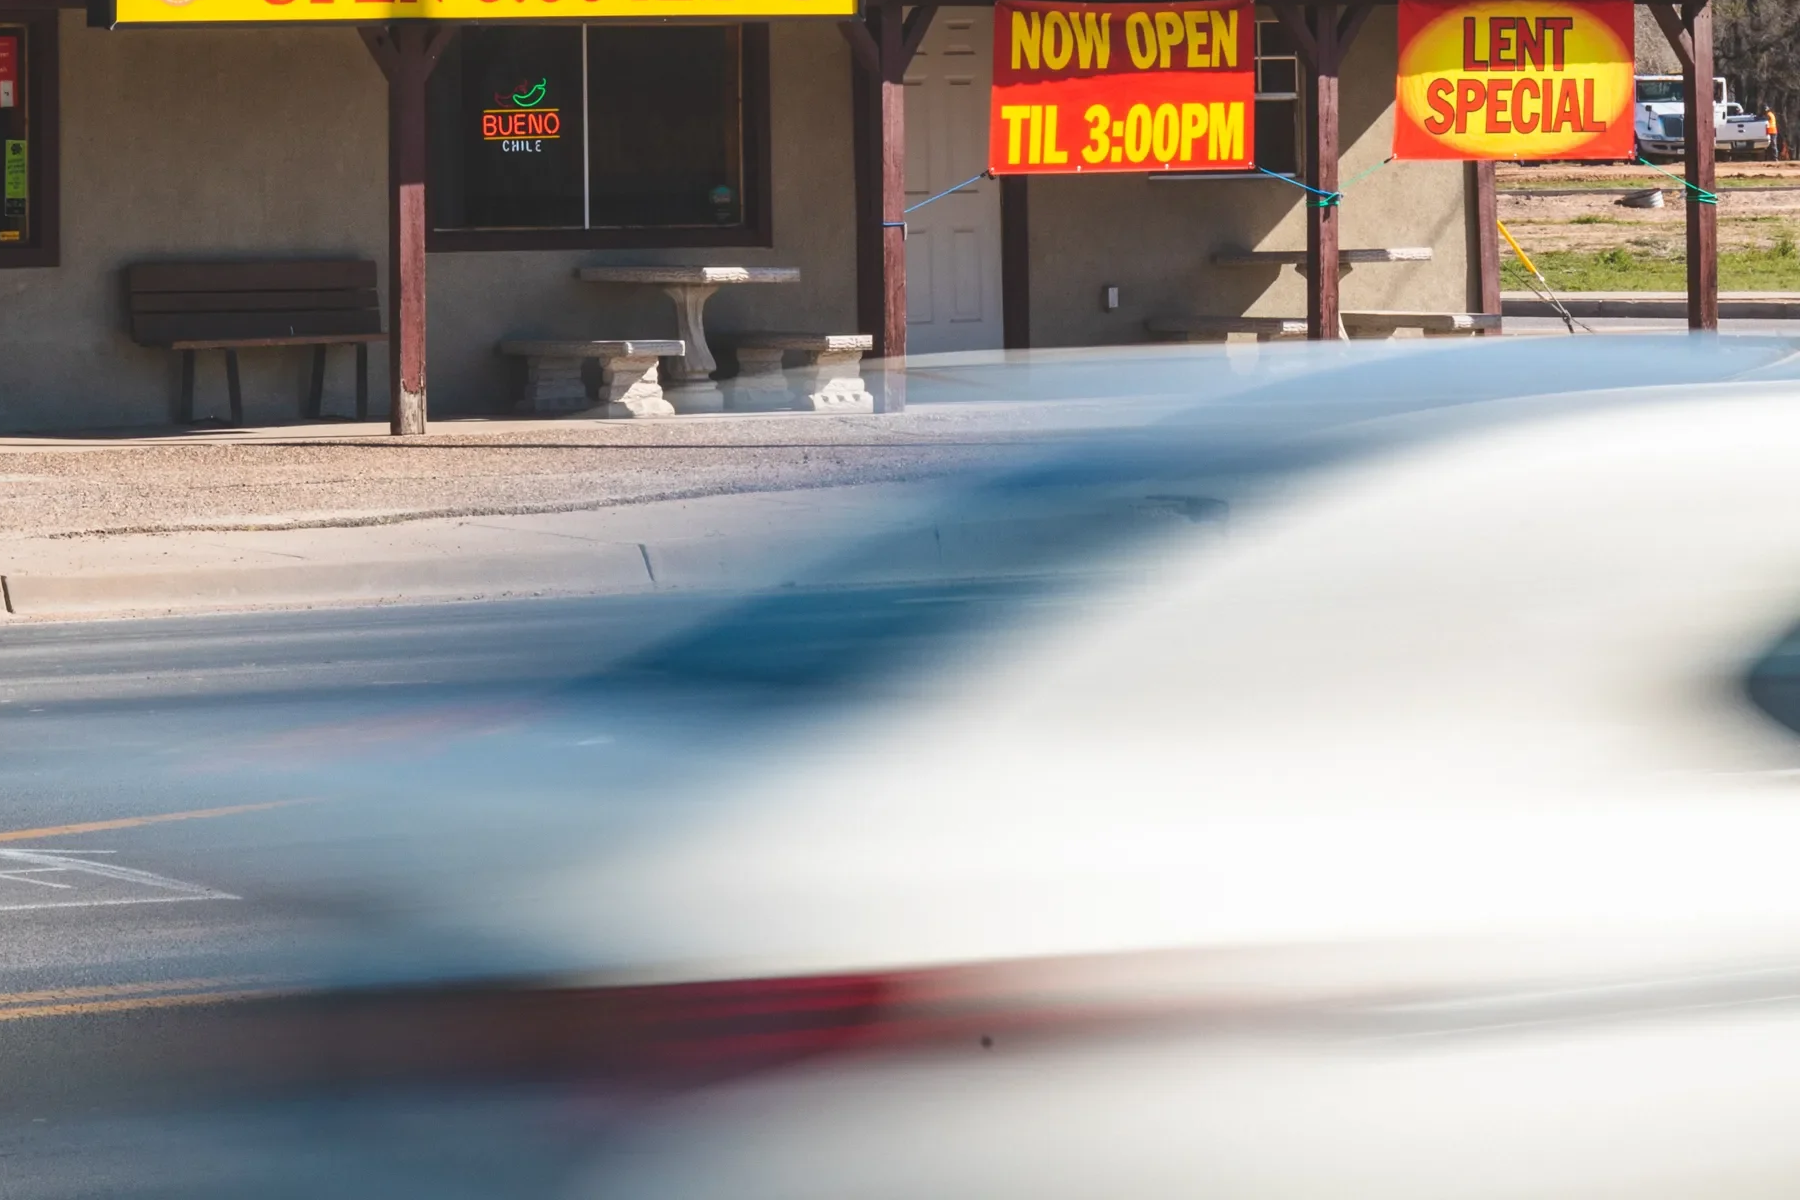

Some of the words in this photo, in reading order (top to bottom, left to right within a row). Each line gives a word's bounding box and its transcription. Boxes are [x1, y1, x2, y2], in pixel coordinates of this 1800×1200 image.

[1011, 10, 1112, 70] NOW
[1125, 9, 1238, 70] OPEN
[1463, 16, 1573, 72] LENT
[482, 112, 560, 136] BUENO
[1001, 104, 1069, 165] TIL
[1080, 101, 1245, 164] 3:00PM
[1424, 78, 1607, 135] SPECIAL
[502, 139, 543, 152] CHILE
